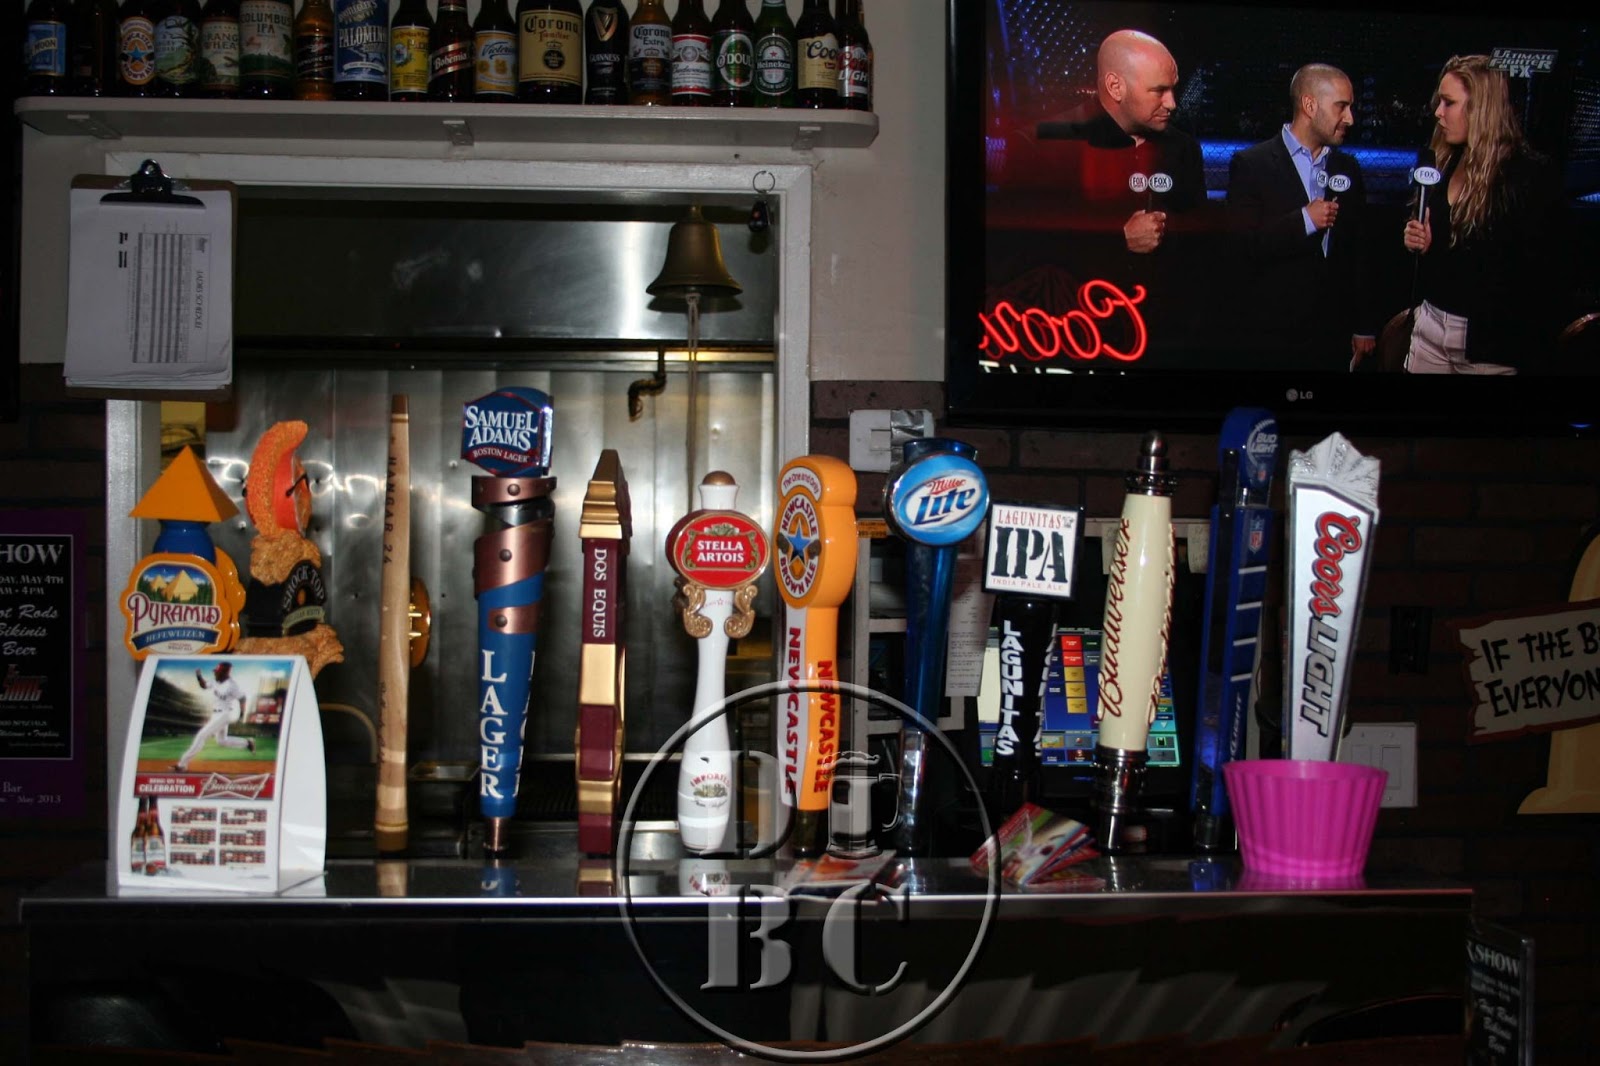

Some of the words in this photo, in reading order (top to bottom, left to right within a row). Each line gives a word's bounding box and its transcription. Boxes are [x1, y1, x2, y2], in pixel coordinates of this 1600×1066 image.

[257, 23, 275, 34] IPA
[524, 15, 578, 34] Corona
[633, 26, 671, 41] Corona
[34, 39, 57, 53] MOON
[643, 39, 665, 48] Extra
[434, 53, 468, 70] Bohemia
[590, 54, 621, 63] GUINNESS
[757, 61, 791, 71] Heineken
[1510, 65, 1532, 79] FX
[1300, 390, 1313, 400] LG
[465, 405, 539, 433] SAMUEL
[468, 426, 531, 451] ADAMS
[1256, 432, 1278, 443] BUD
[473, 447, 503, 458] BOSTON
[503, 451, 530, 463] LAGER
[1252, 442, 1279, 454] LIGHT
[385, 457, 397, 533] HANGAR
[925, 478, 967, 495] Miller
[913, 488, 976, 526] Lite
[782, 497, 818, 535] NEWCASTLE
[998, 510, 1062, 529] LAGUNITAS
[383, 544, 393, 564] 24
[697, 540, 744, 551] STELLA
[697, 552, 745, 563] ARTOIS
[991, 526, 1068, 584] IPA
[594, 548, 608, 582] DOS
[1308, 511, 1362, 618] Coors
[311, 568, 325, 600] TOP
[780, 557, 804, 595] BROWN
[804, 562, 816, 587] ALE
[993, 578, 1016, 587] INDIA
[1021, 581, 1042, 589] PALE
[18, 604, 59, 620] Rods
[128, 592, 221, 633] PYRAMID
[592, 589, 607, 638] EQUIS
[1097, 518, 1130, 722] Budweiser
[0, 621, 48, 638] Bikinis
[146, 629, 206, 643] HEFEWEIZEN
[2, 640, 38, 656] Beer
[1481, 639, 1510, 674] IF
[1518, 628, 1574, 663] THE
[1578, 622, 1600, 654] B
[1300, 613, 1338, 738] LIGHT
[996, 619, 1025, 757] LAGUNITAS
[785, 627, 801, 794] NEWCASTLE
[480, 649, 508, 799] LAGER
[814, 660, 836, 793] NEWCASTLE
[2, 781, 22, 793] Bar
[140, 783, 196, 794] CELEBRATION
[36, 794, 62, 804] 2013
